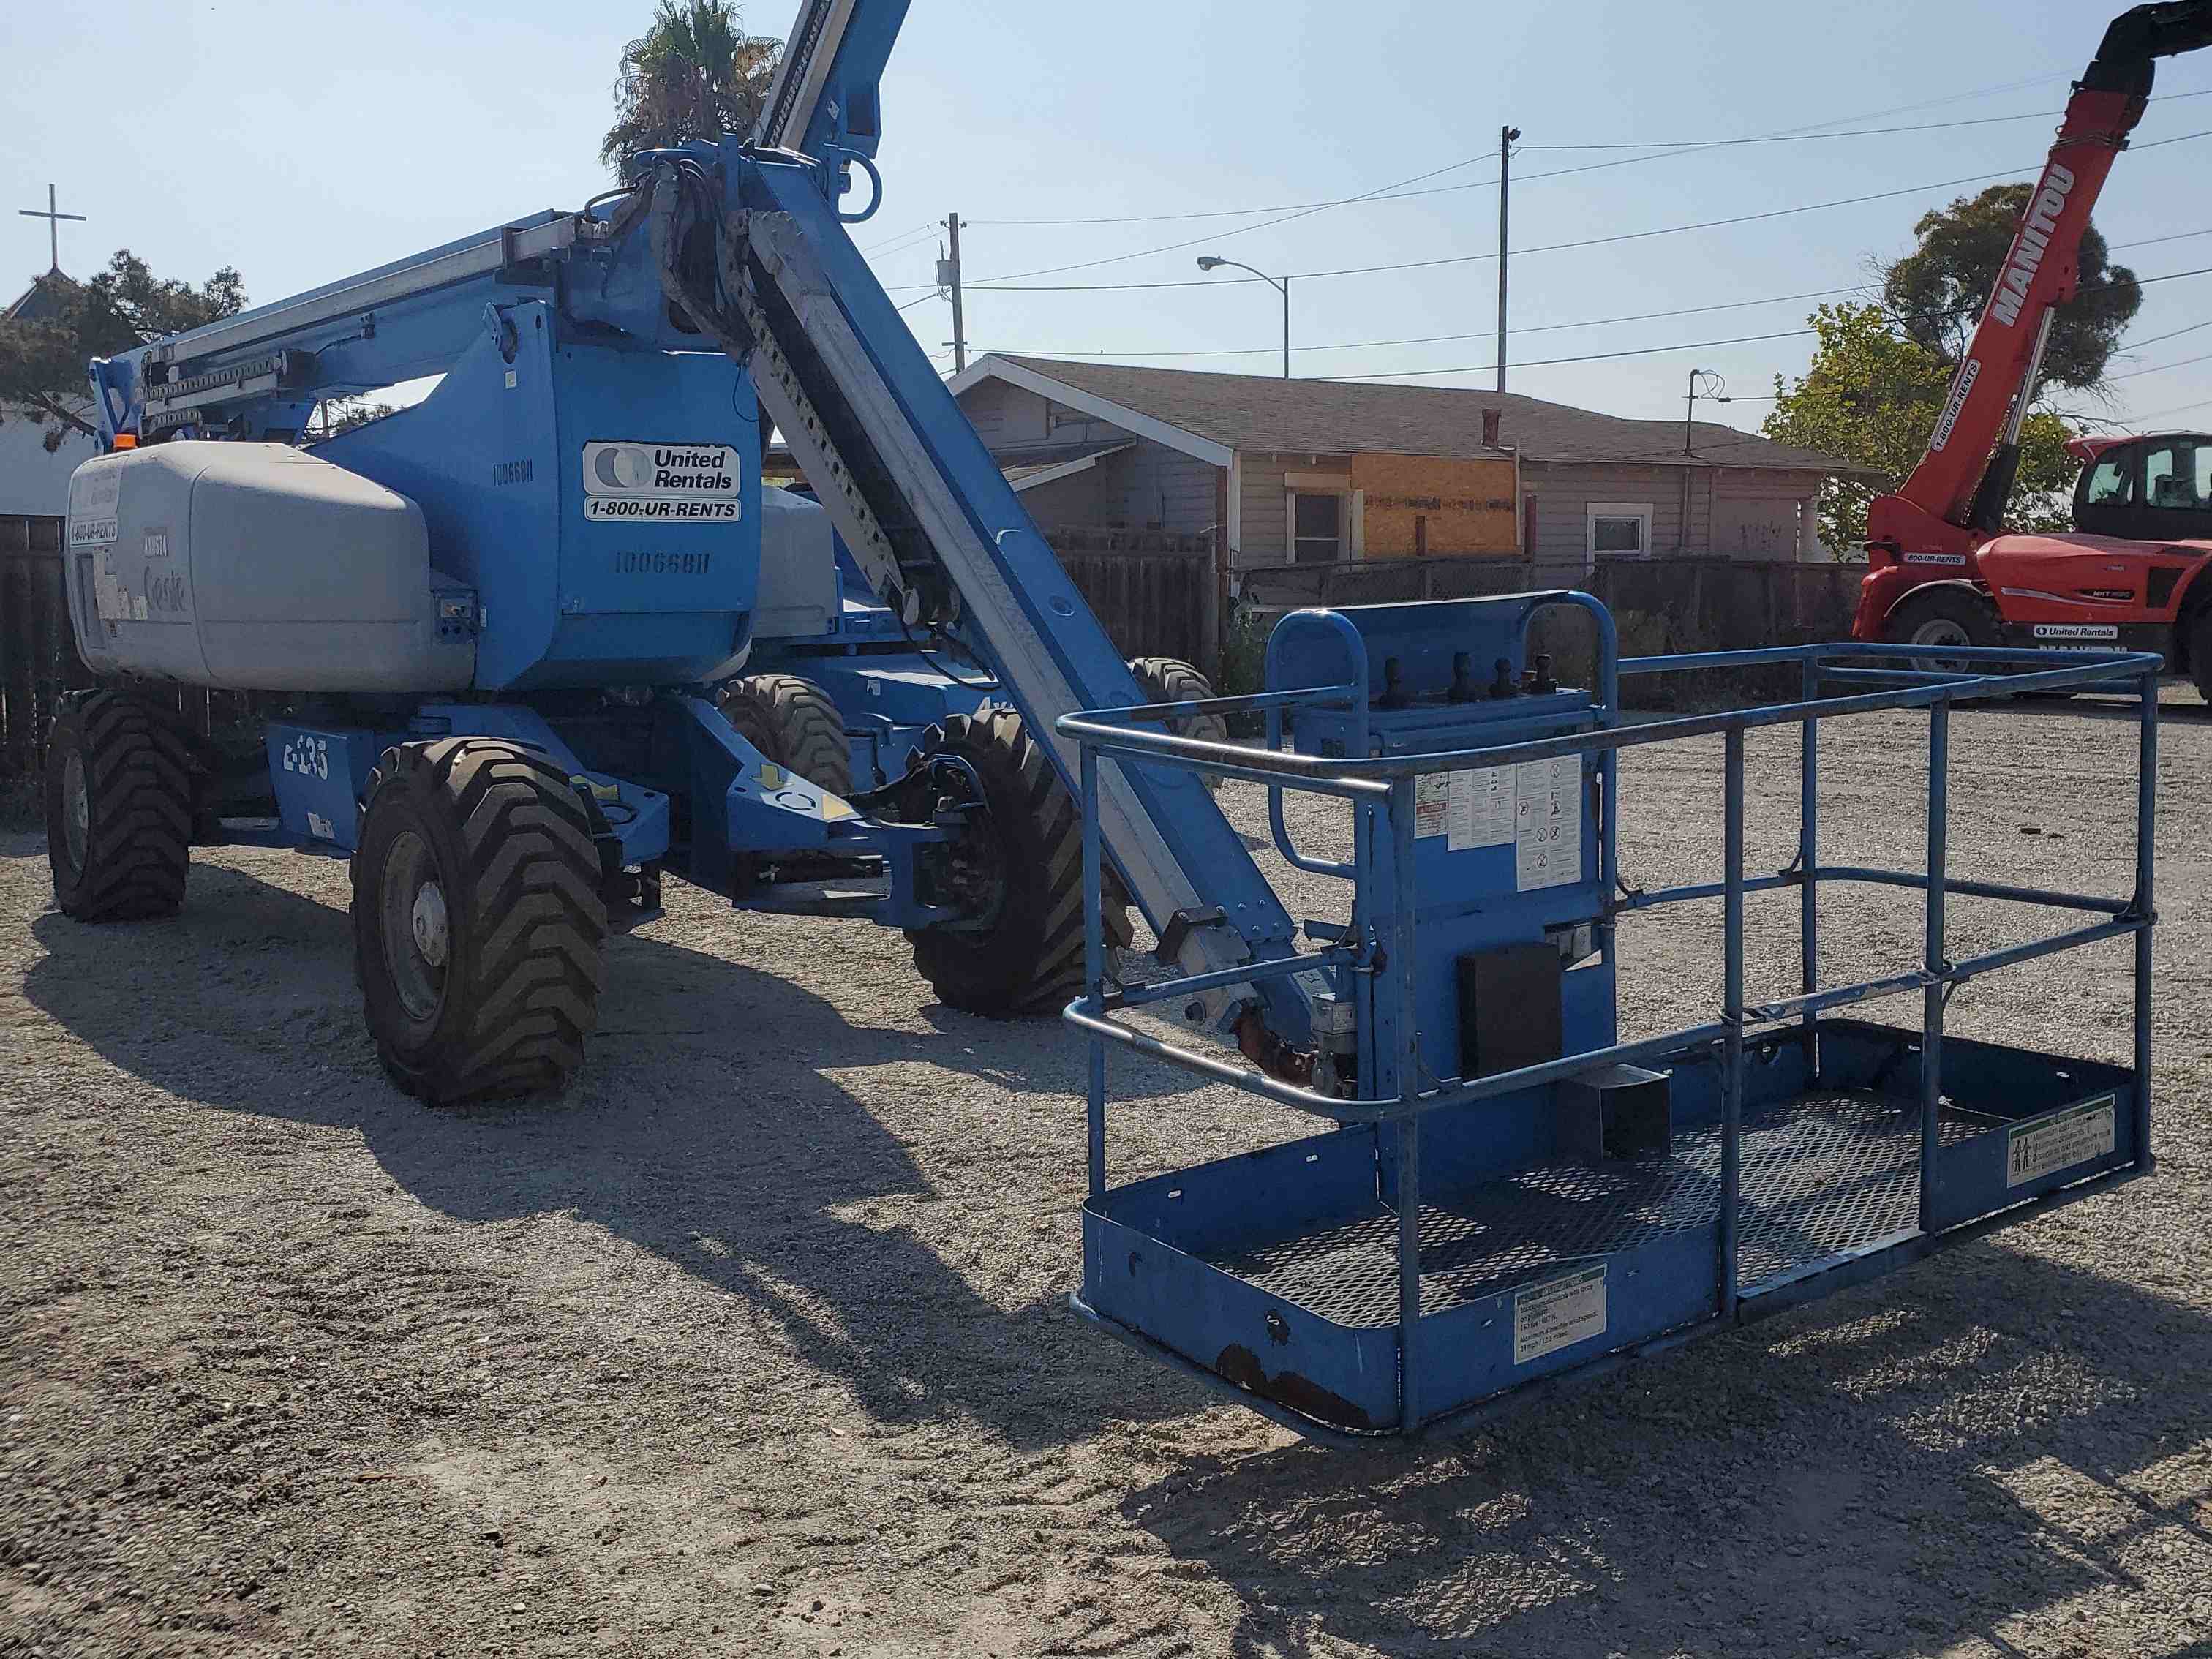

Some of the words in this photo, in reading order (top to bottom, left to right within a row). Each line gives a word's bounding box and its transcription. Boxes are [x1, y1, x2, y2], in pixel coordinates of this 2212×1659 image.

[1992, 163, 2075, 327] MANITOU
[1936, 362, 1979, 448] 1-800-UR-RENTS
[654, 449, 725, 469] United
[654, 470, 732, 489] Rentals
[590, 501, 736, 518] 1-800-UR-RENTS
[72, 522, 116, 541] 1-800-UR-RENTS
[2049, 628, 2079, 636] United
[2080, 628, 2113, 637] Rentals
